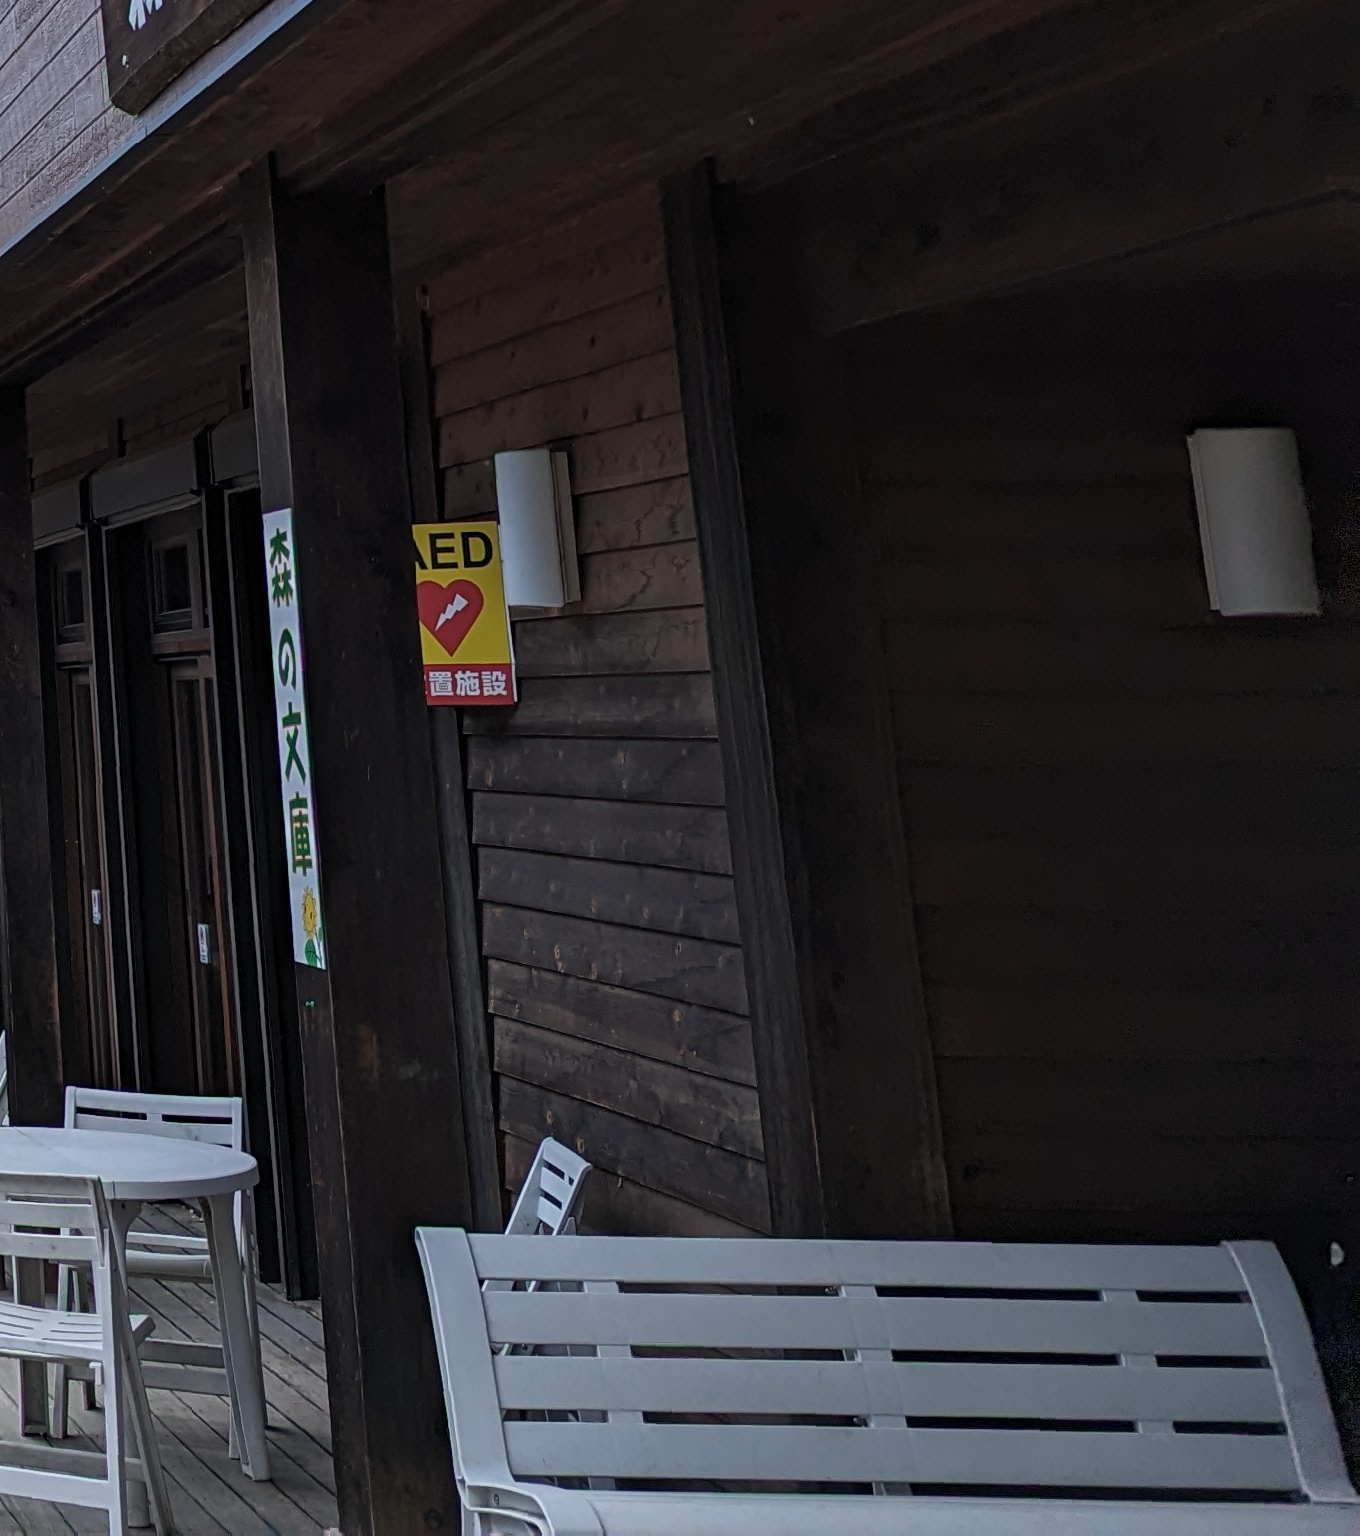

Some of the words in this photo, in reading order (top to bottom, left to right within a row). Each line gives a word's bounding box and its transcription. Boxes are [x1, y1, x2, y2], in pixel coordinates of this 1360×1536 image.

[269, 527, 314, 877] 森の文庫
[424, 670, 508, 696] 置施設
